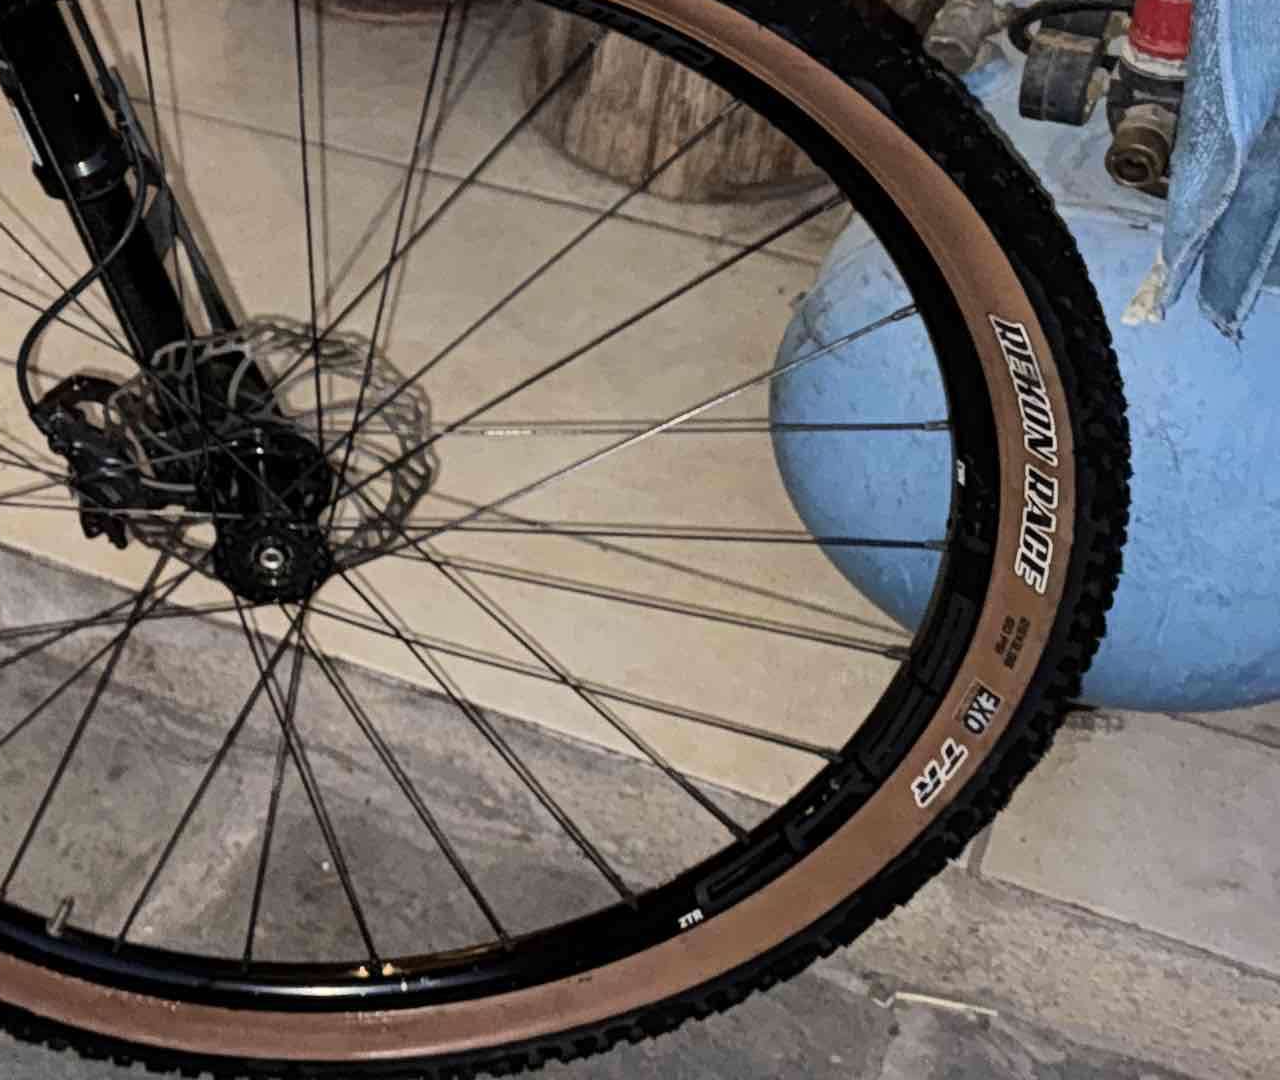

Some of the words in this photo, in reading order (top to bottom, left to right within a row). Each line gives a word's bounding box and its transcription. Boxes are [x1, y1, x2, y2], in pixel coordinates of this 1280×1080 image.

[989, 314, 1059, 468] REKON
[1013, 464, 1059, 595] RACE
[963, 685, 1002, 735] EXO
[677, 908, 705, 929] ZTR
